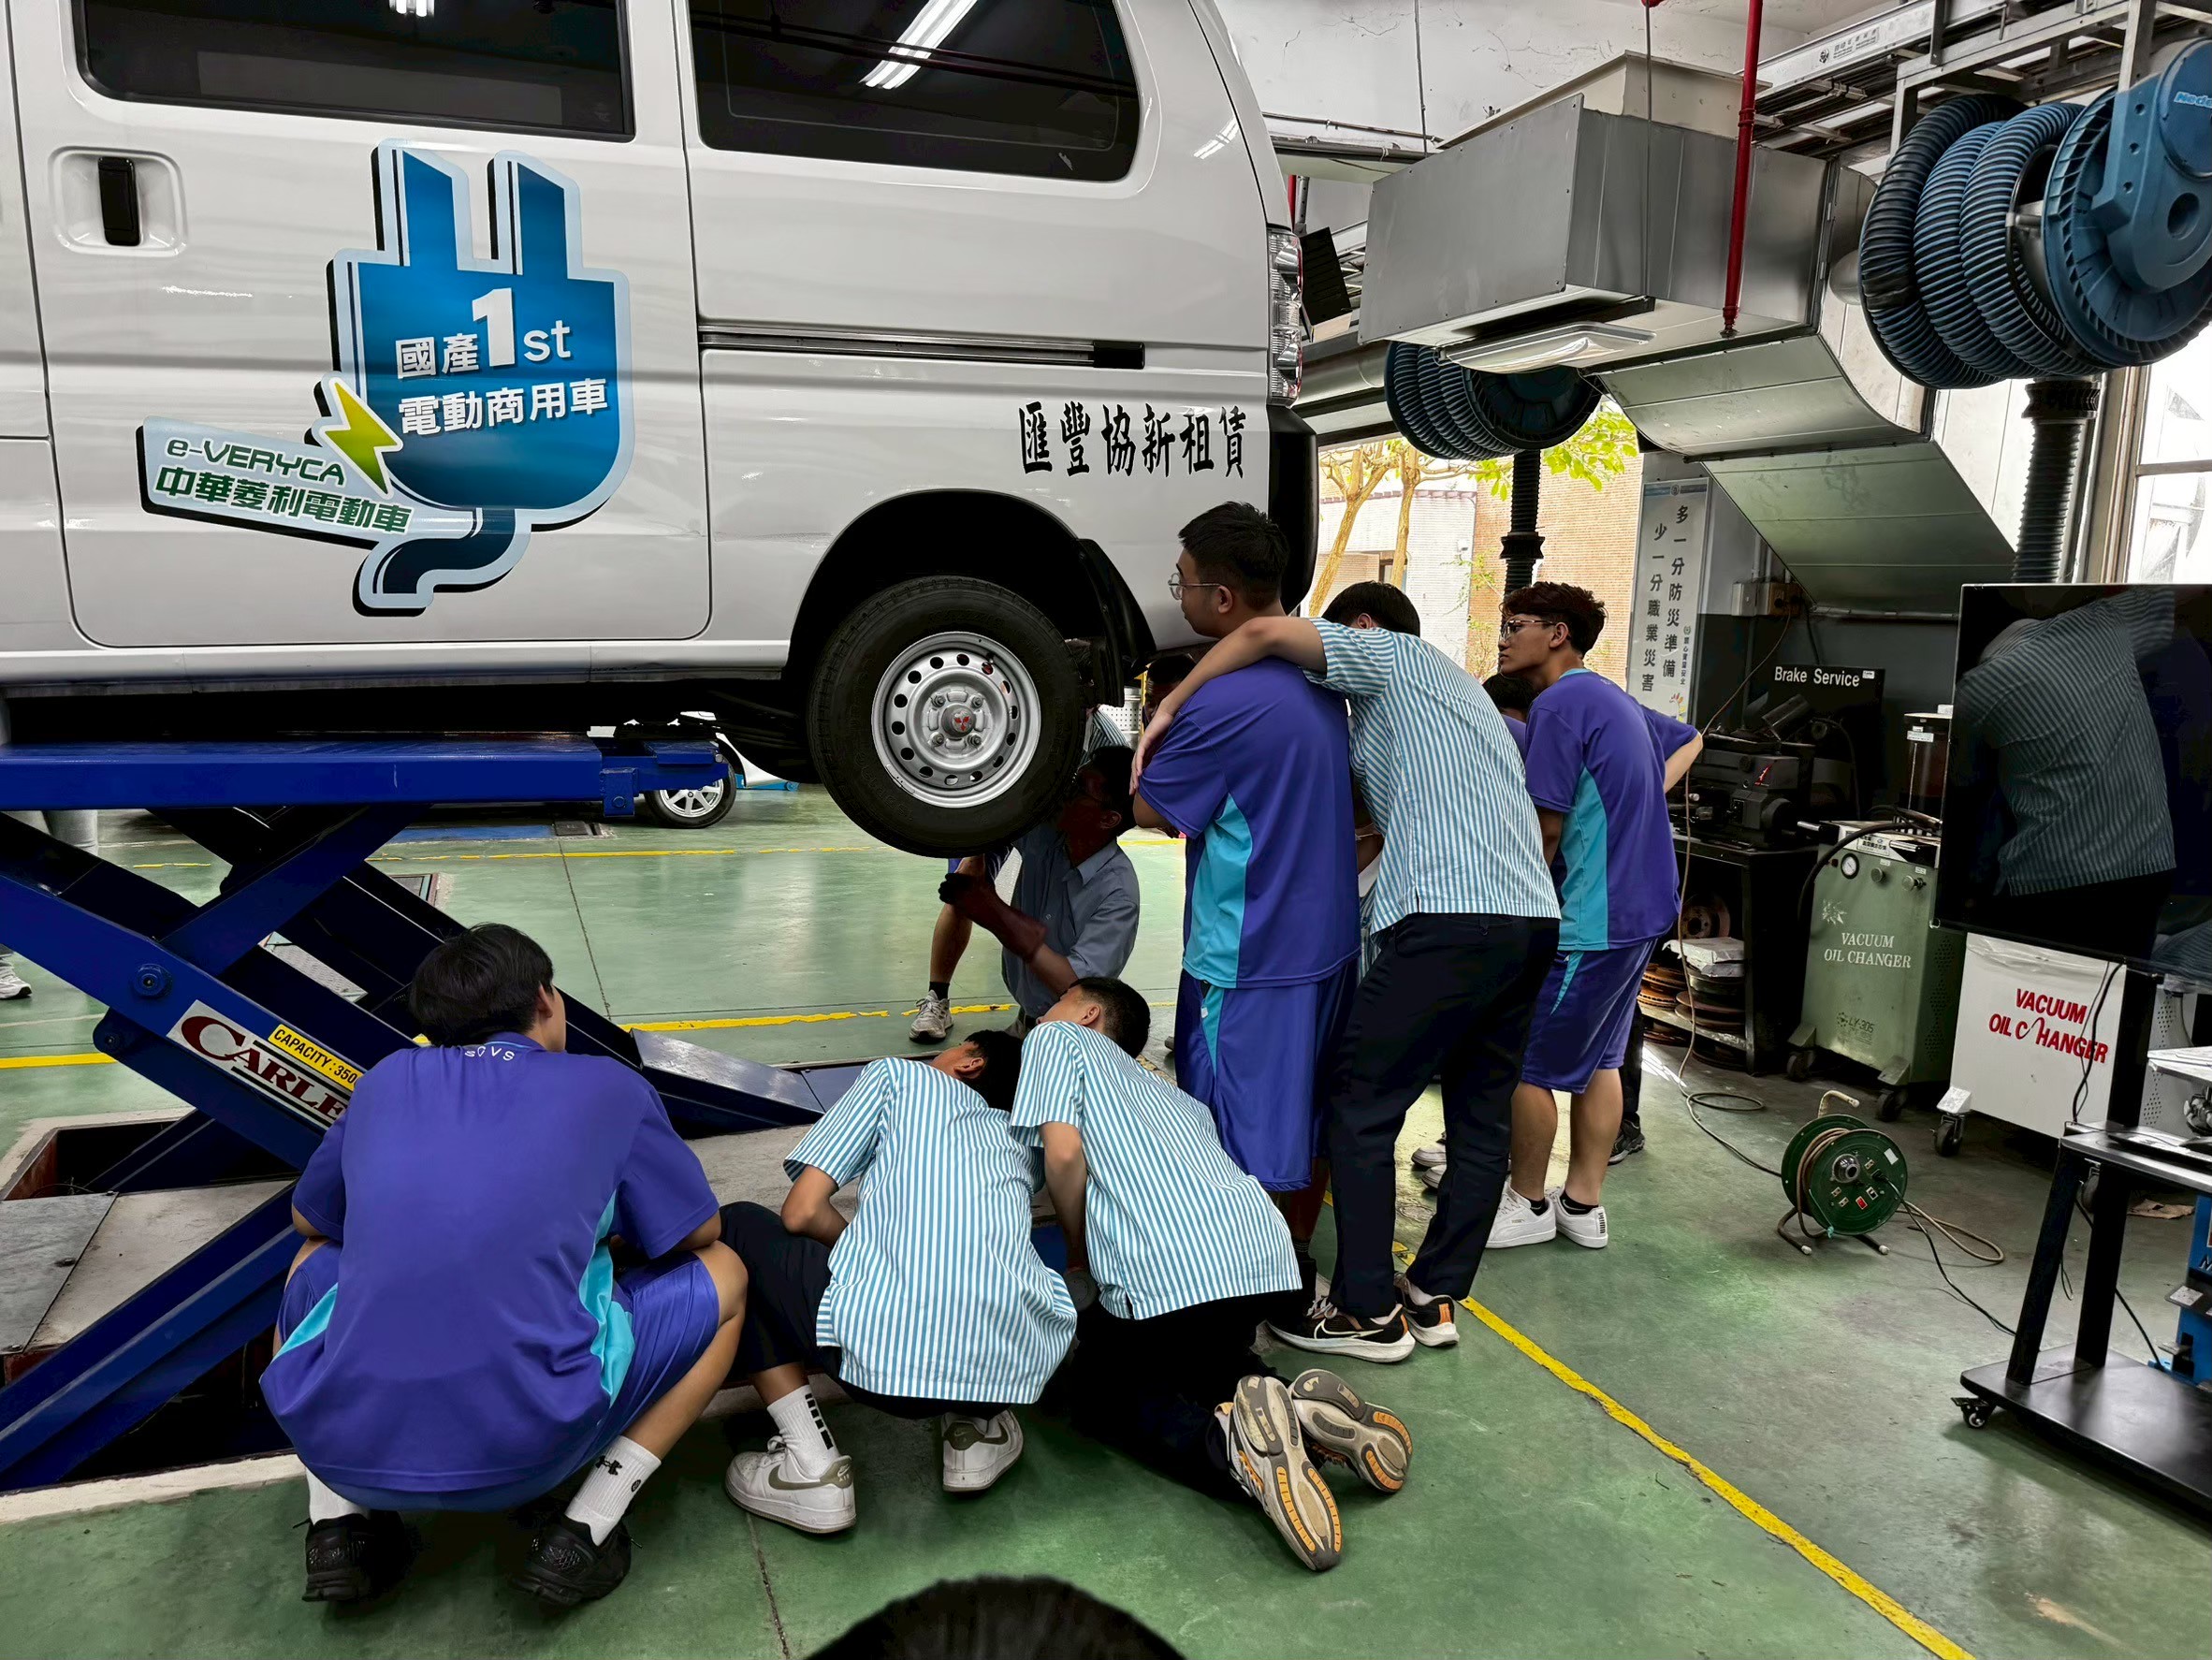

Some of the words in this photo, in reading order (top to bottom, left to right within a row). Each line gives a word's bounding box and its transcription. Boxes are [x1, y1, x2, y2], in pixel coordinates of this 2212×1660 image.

[399, 378, 608, 435] 電動商用車
[167, 439, 345, 486] e-VERYCA
[1019, 400, 1246, 478] 匯豐協新租賃
[155, 467, 413, 533] 中華菱利電動車
[1641, 522, 1667, 692] 少一分職業災害
[1663, 505, 1689, 677] 多一分防災準備
[1774, 666, 1807, 682] Brake
[1813, 668, 1860, 687] Service
[1824, 948, 1844, 962] OIL
[1847, 951, 1912, 968] CHANGER
[1841, 932, 1895, 948] VACUUM
[1988, 1013, 2012, 1037] OIL
[2016, 988, 2088, 1025] VACUUM
